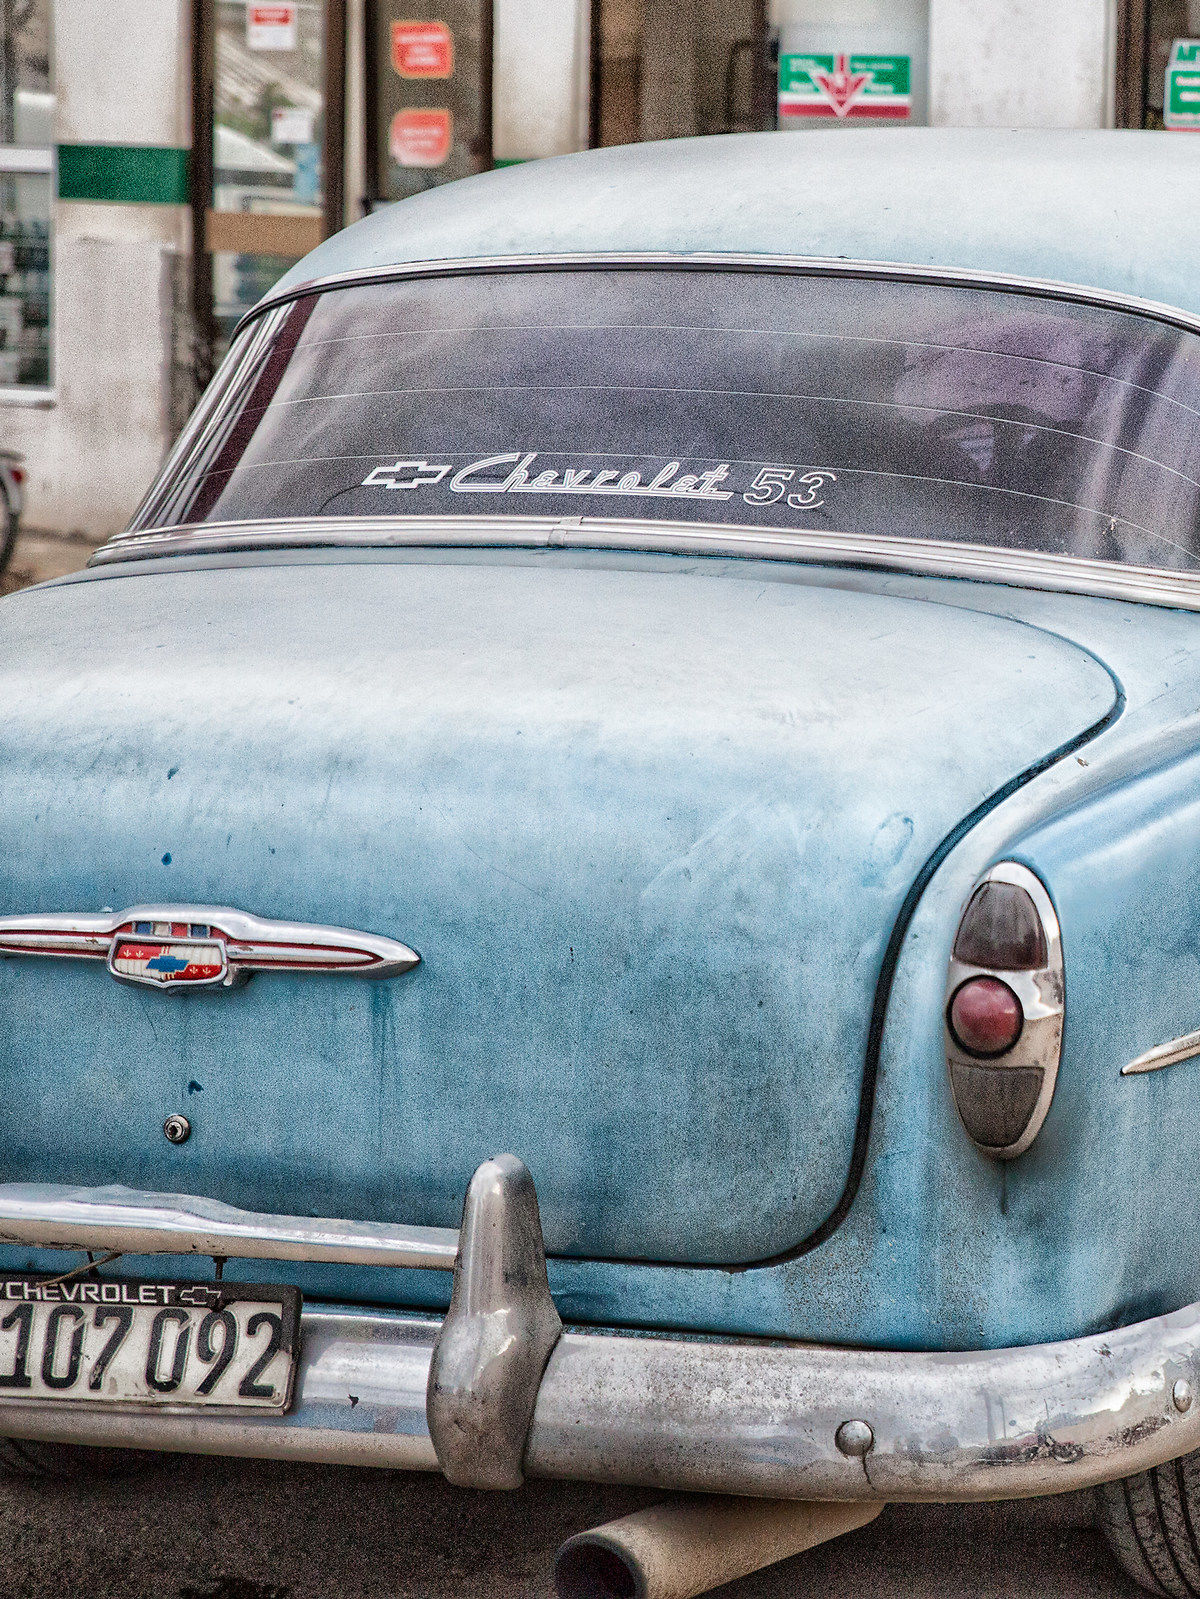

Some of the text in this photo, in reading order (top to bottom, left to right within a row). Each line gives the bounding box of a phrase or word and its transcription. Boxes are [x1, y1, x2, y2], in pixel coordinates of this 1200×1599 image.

[449, 453, 837, 509] Chevrolet 53
[6, 1280, 176, 1304] CHEVROLET
[0, 1303, 284, 1398] 107 092
